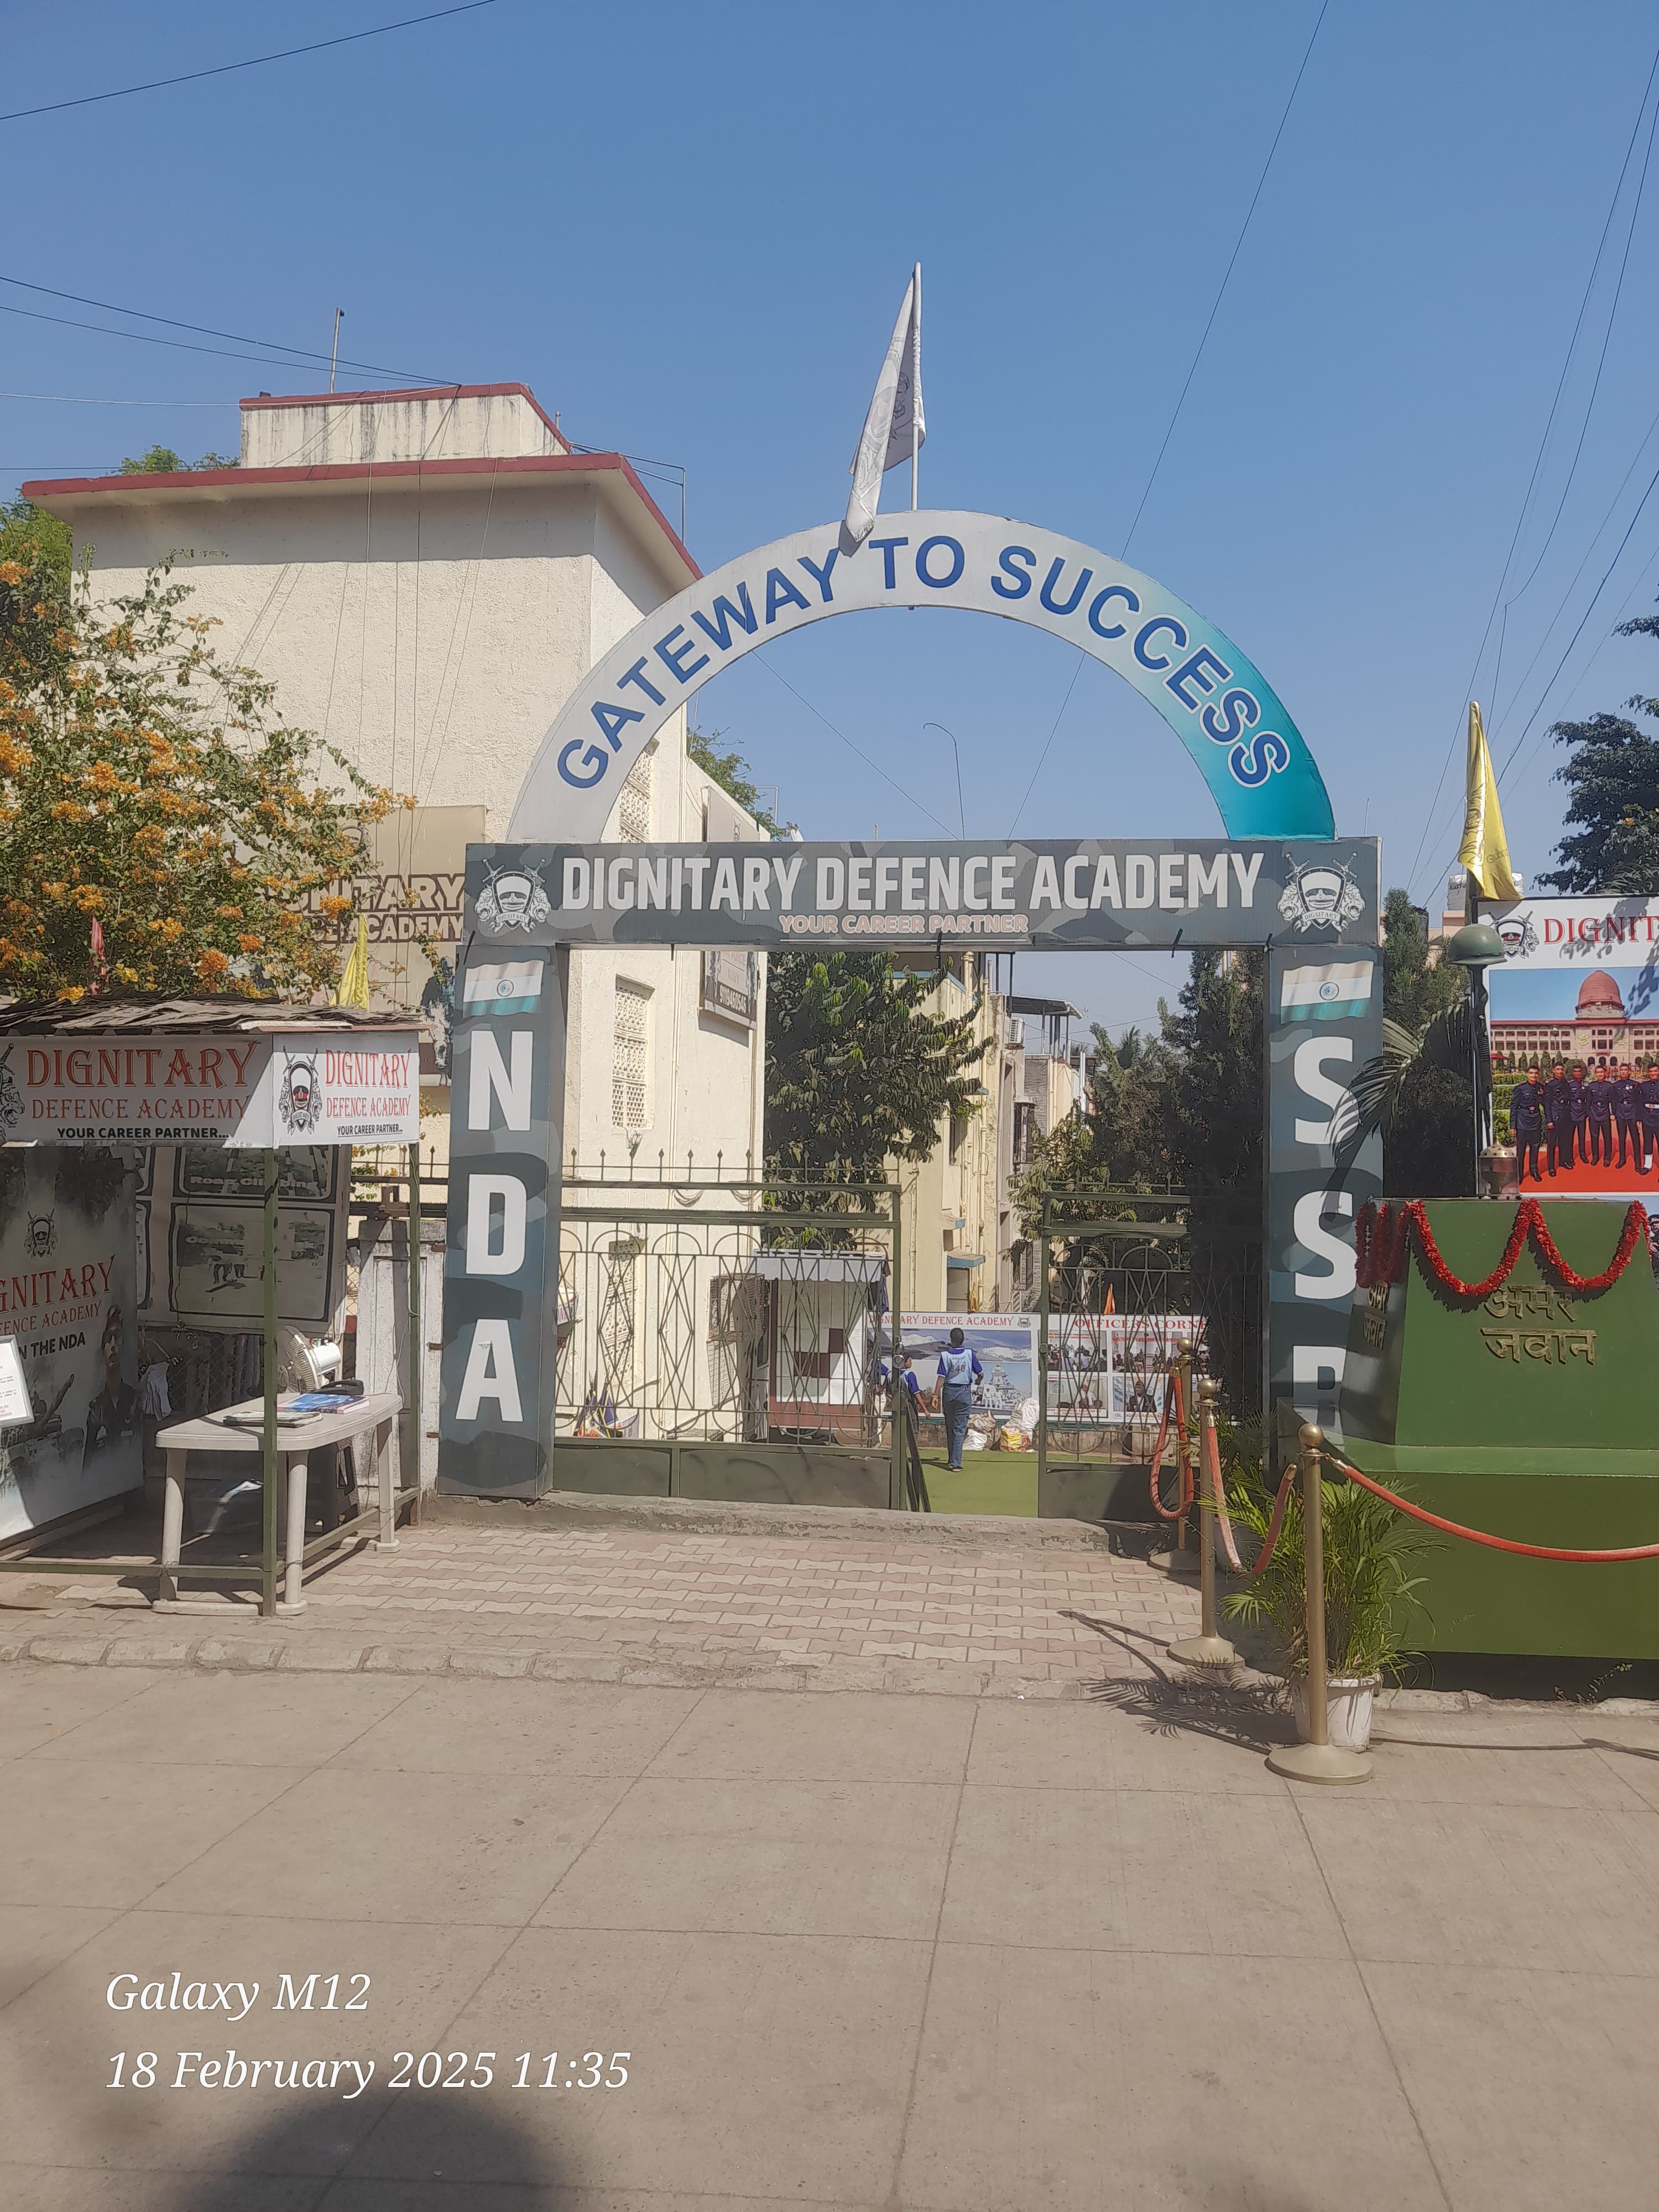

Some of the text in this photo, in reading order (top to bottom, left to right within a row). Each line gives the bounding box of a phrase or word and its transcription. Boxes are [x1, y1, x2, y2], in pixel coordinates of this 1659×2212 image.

[556, 535, 1287, 789] GATEWAY TO SUCCESS
[562, 853, 1265, 910] DIGNITARY DEFENCE ACADEMY
[779, 914, 1029, 933] YOUR CAREER PARTNER
[27, 1040, 260, 1089] DIGNITARY
[325, 1048, 411, 1088] DIGNITARY
[32, 1094, 252, 1119] DEFENCE ACADEMY
[326, 1093, 411, 1118] DEFENCE ACADEMY
[57, 1128, 229, 1139] YOUR CAREER PARTNER...
[337, 1125, 353, 1135] YOUR
[354, 1124, 375, 1134] CAREER
[42, 1300, 102, 1327] ACADEMY
[1483, 1285, 1577, 1322] अमर
[922, 1316, 963, 1325] DEFENCE
[966, 1316, 1014, 1326] ACADEMY
[1074, 1319, 1150, 1328] OFFICERS
[31, 1338, 55, 1358] THE
[59, 1332, 86, 1351] NDA
[1480, 1327, 1598, 1365] जवान
